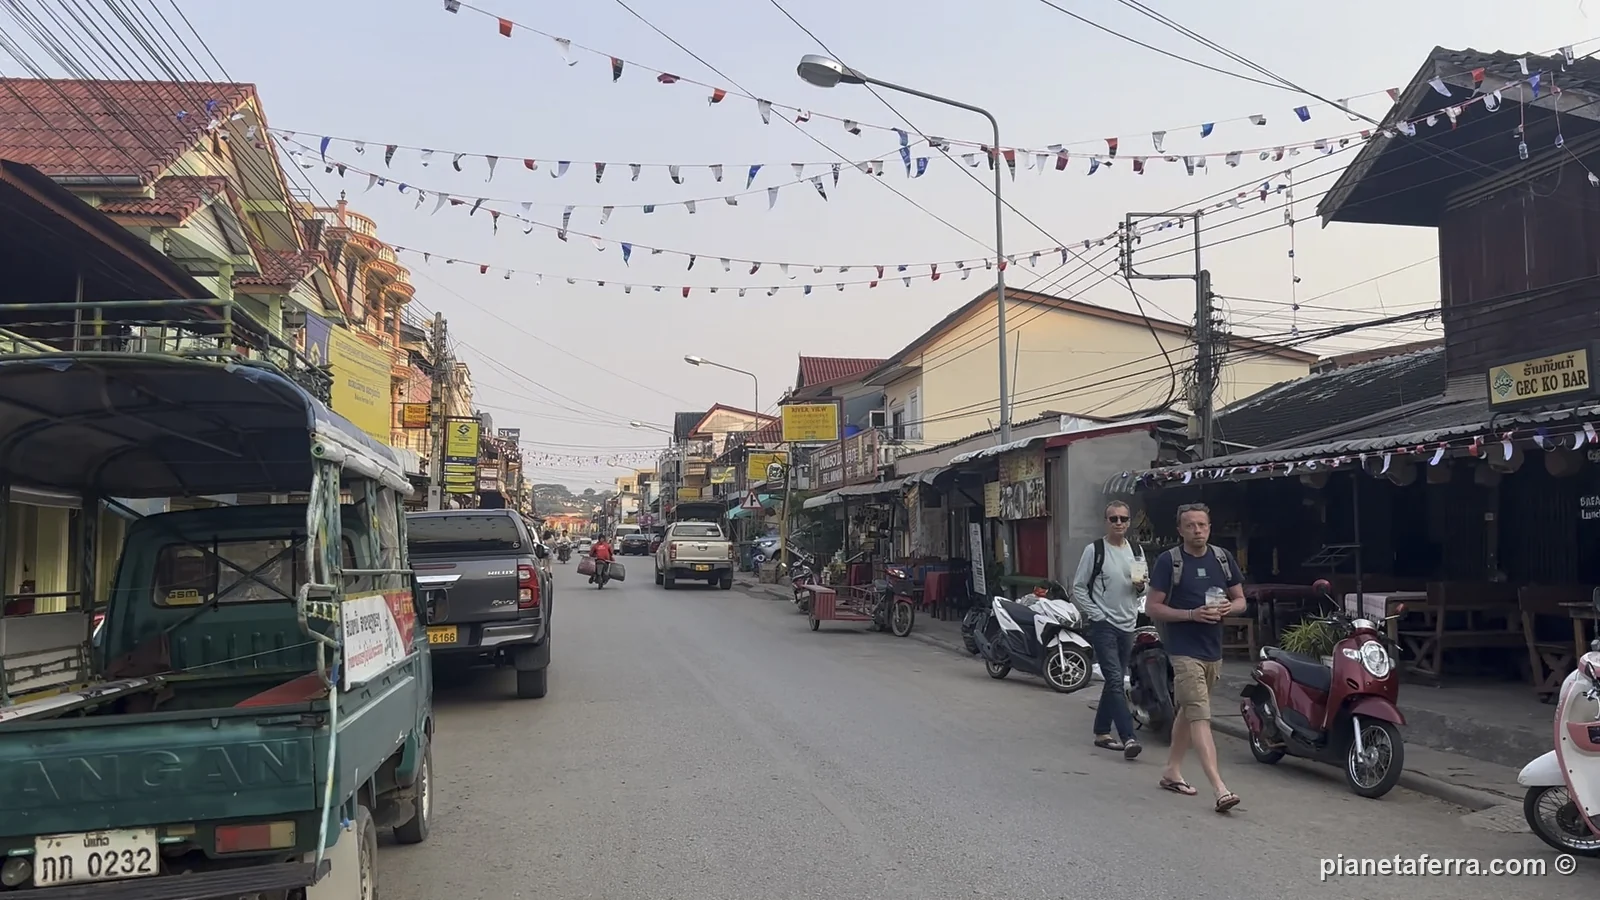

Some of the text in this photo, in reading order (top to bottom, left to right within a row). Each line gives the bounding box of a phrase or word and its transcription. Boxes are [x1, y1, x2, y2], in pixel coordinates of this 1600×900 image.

[1515, 378, 1538, 396] GEC
[1542, 375, 1558, 392] KO
[1562, 369, 1587, 388] BAR
[432, 632, 455, 643] 6166
[87, 847, 152, 878] 0232
